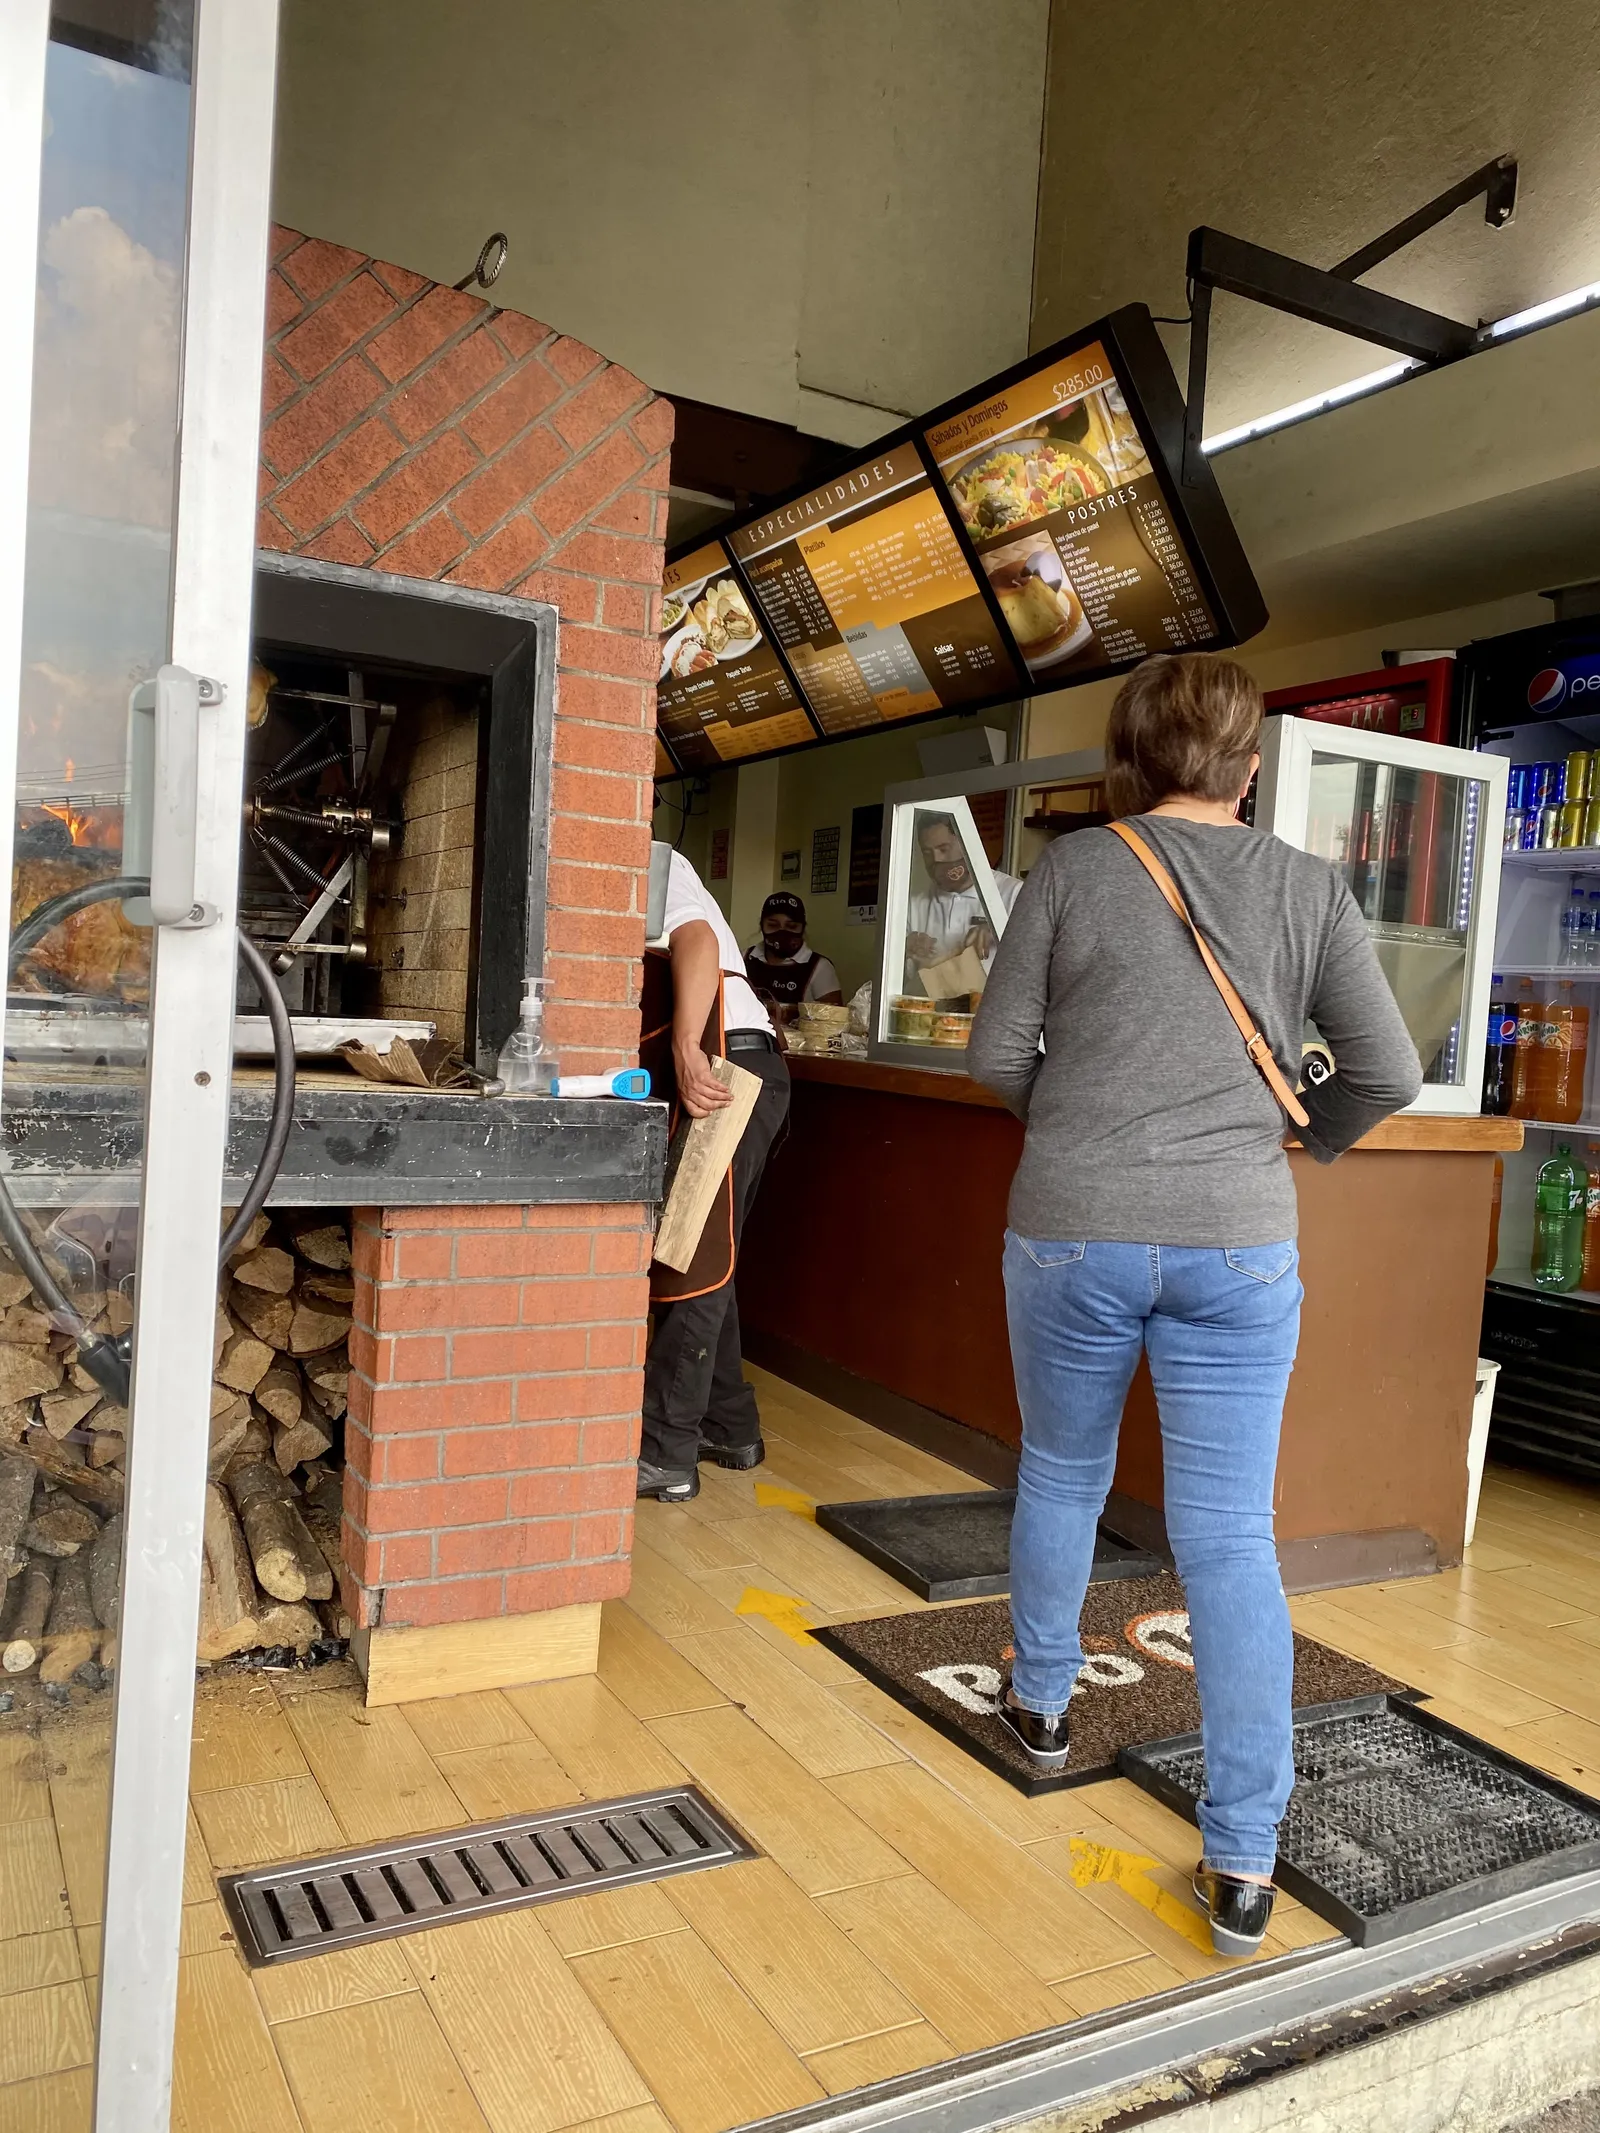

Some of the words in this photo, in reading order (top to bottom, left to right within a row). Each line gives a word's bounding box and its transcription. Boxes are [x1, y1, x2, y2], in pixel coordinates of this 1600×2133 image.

[1052, 365, 1103, 402] $285.00
[931, 424, 962, 447] Sábados
[961, 420, 970, 435] y
[967, 400, 1008, 428] Domingos
[749, 461, 894, 542] ESPECIALIDADES
[1067, 486, 1137, 524] POSTRES
[1143, 499, 1159, 511] 91.00
[1147, 508, 1163, 519] 12.00
[1151, 517, 1166, 527] 46.00
[803, 540, 826, 555] Platillos
[1065, 560, 1076, 568] Pan
[1153, 525, 1169, 536] 24.00
[1161, 543, 1177, 554] 32.00
[1102, 585, 1109, 593] de
[1168, 560, 1184, 571] 36.00
[1175, 576, 1191, 587] 12.00
[1104, 593, 1116, 601] casa
[1171, 568, 1188, 579] 26.00
[1178, 585, 1194, 596] 24.00
[1185, 593, 1198, 602] 7.50
[1188, 607, 1204, 617] 22.00
[1191, 614, 1207, 625] 50.00
[1194, 623, 1210, 633] 25.00
[845, 631, 868, 643] Bebidas
[934, 643, 954, 656] Salsas
